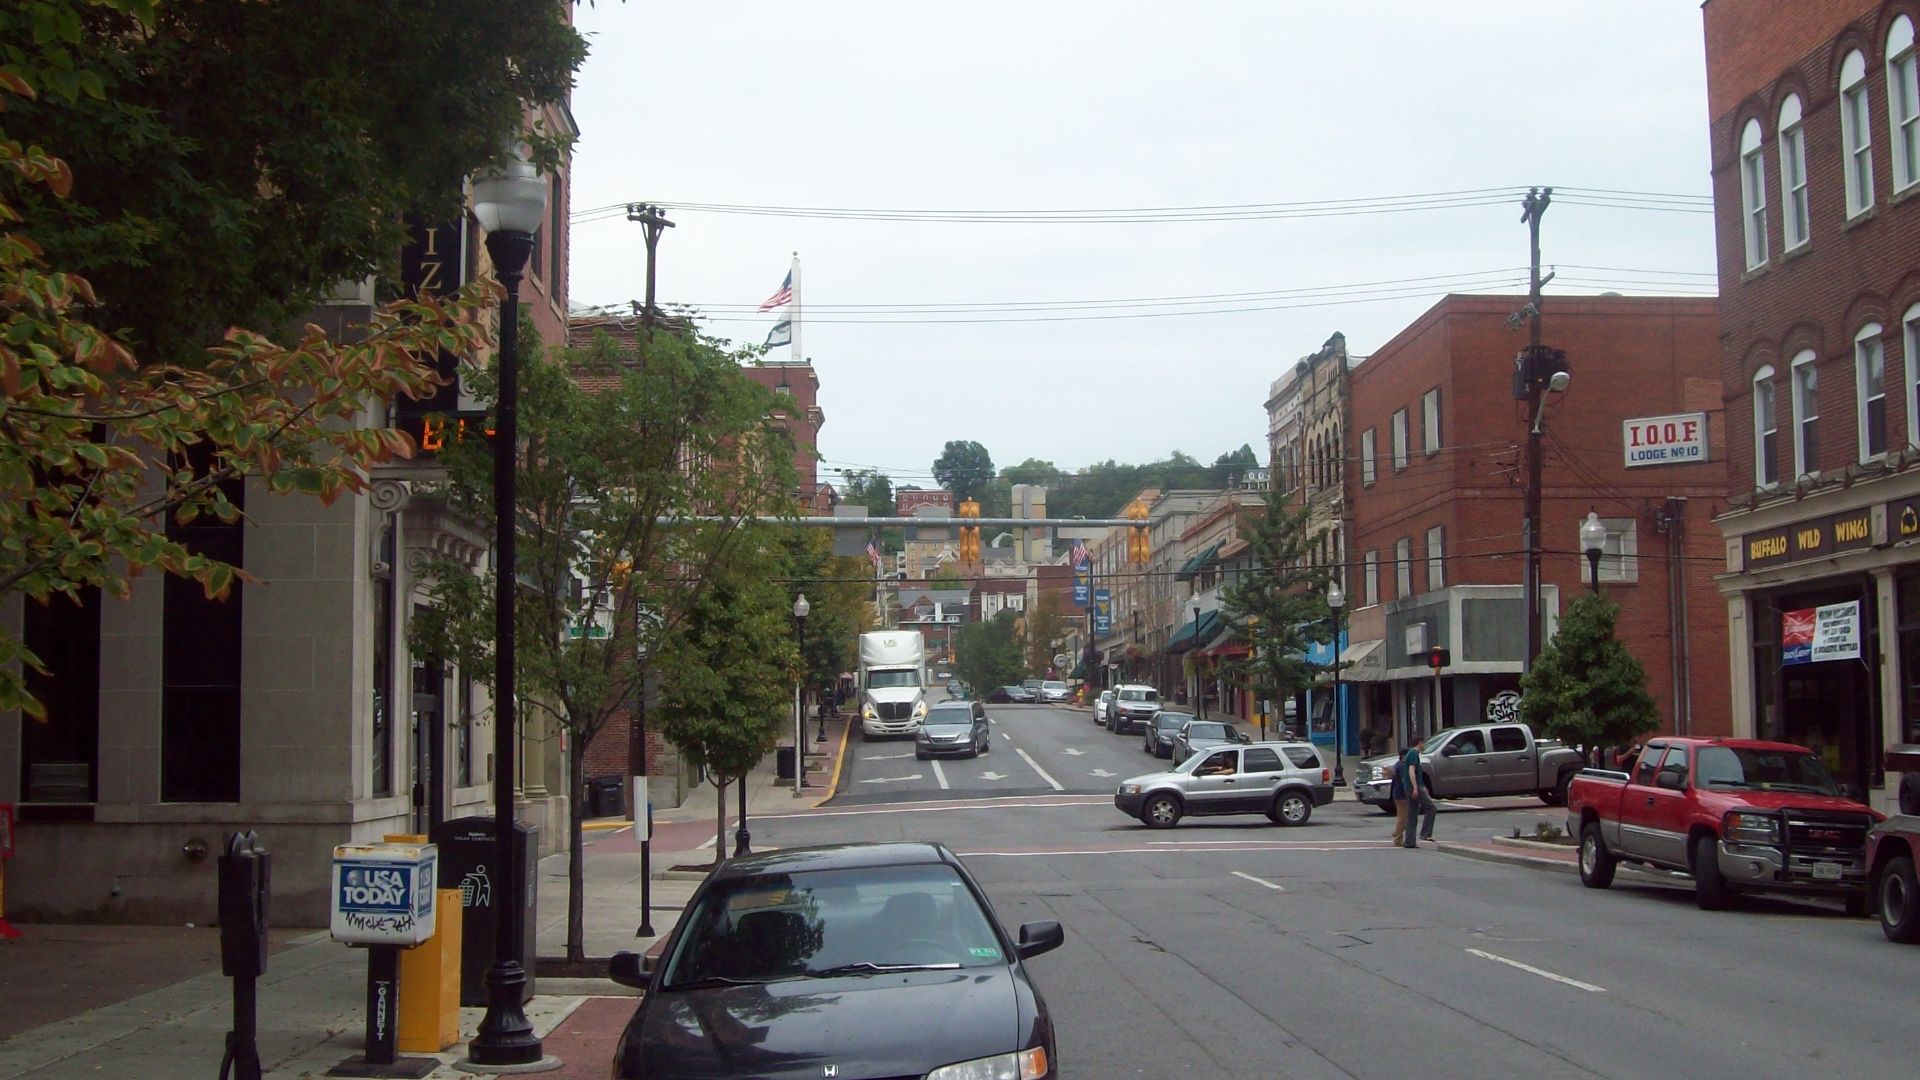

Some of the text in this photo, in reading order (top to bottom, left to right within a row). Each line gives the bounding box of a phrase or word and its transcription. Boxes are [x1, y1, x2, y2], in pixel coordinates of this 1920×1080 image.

[1630, 421, 1698, 447] I.O.O.F.
[1631, 449, 1667, 461] LODGE
[1687, 446, 1699, 456] 10
[1751, 518, 1868, 560] BUFFALO WILD WINGS
[365, 870, 404, 889] USA
[344, 887, 405, 905] TODAY
[377, 987, 387, 1040] GANNETT
